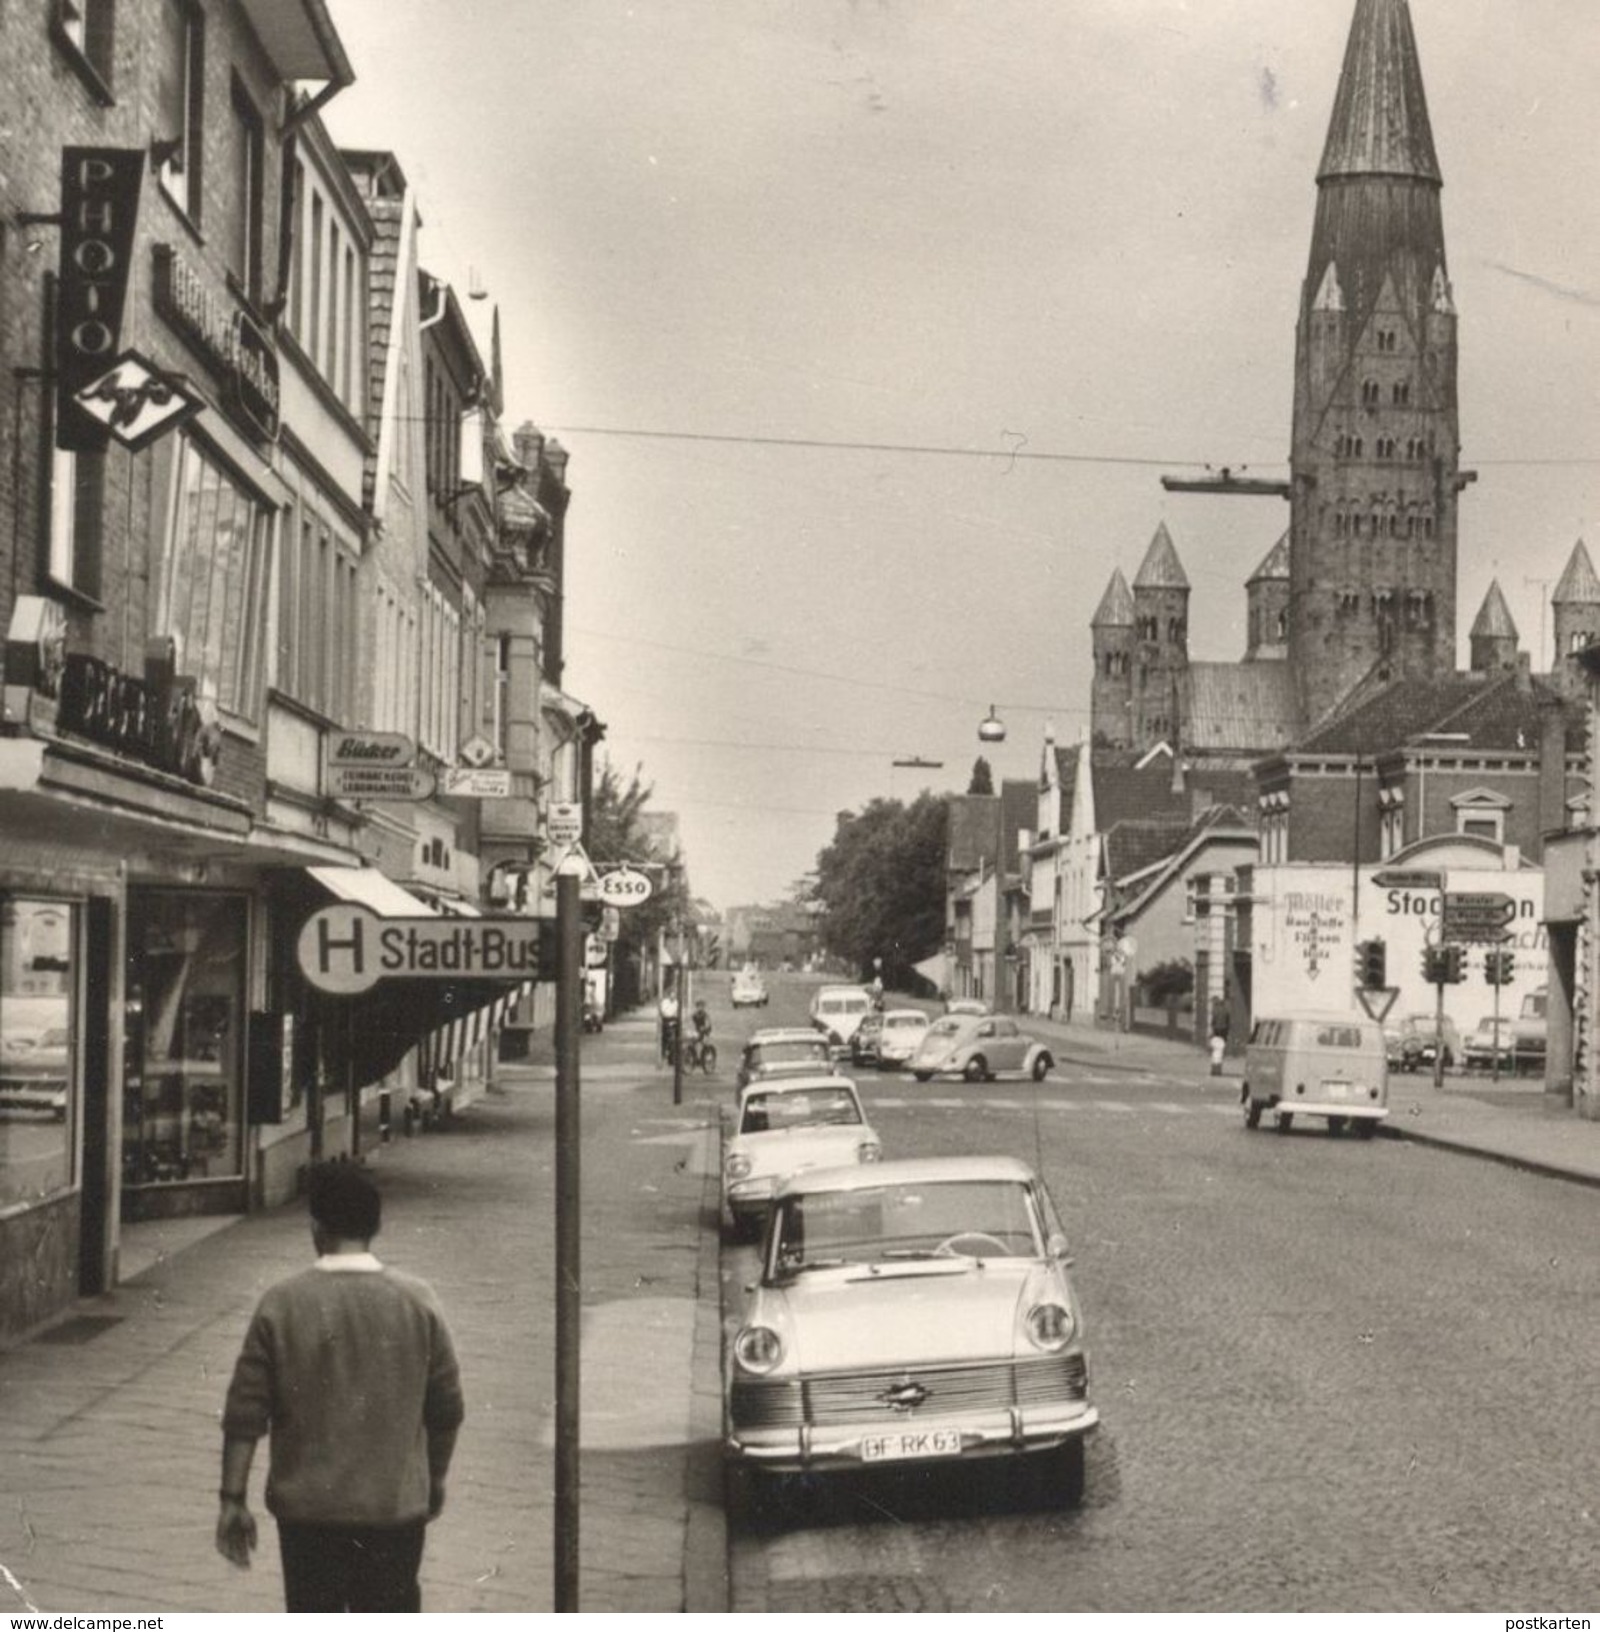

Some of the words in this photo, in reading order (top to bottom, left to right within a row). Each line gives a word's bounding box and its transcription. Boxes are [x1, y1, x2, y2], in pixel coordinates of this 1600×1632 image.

[72, 160, 115, 355] PHOTO
[318, 917, 364, 973] H
[380, 926, 541, 970] Stadt-Bus
[933, 1430, 959, 1451] 63
